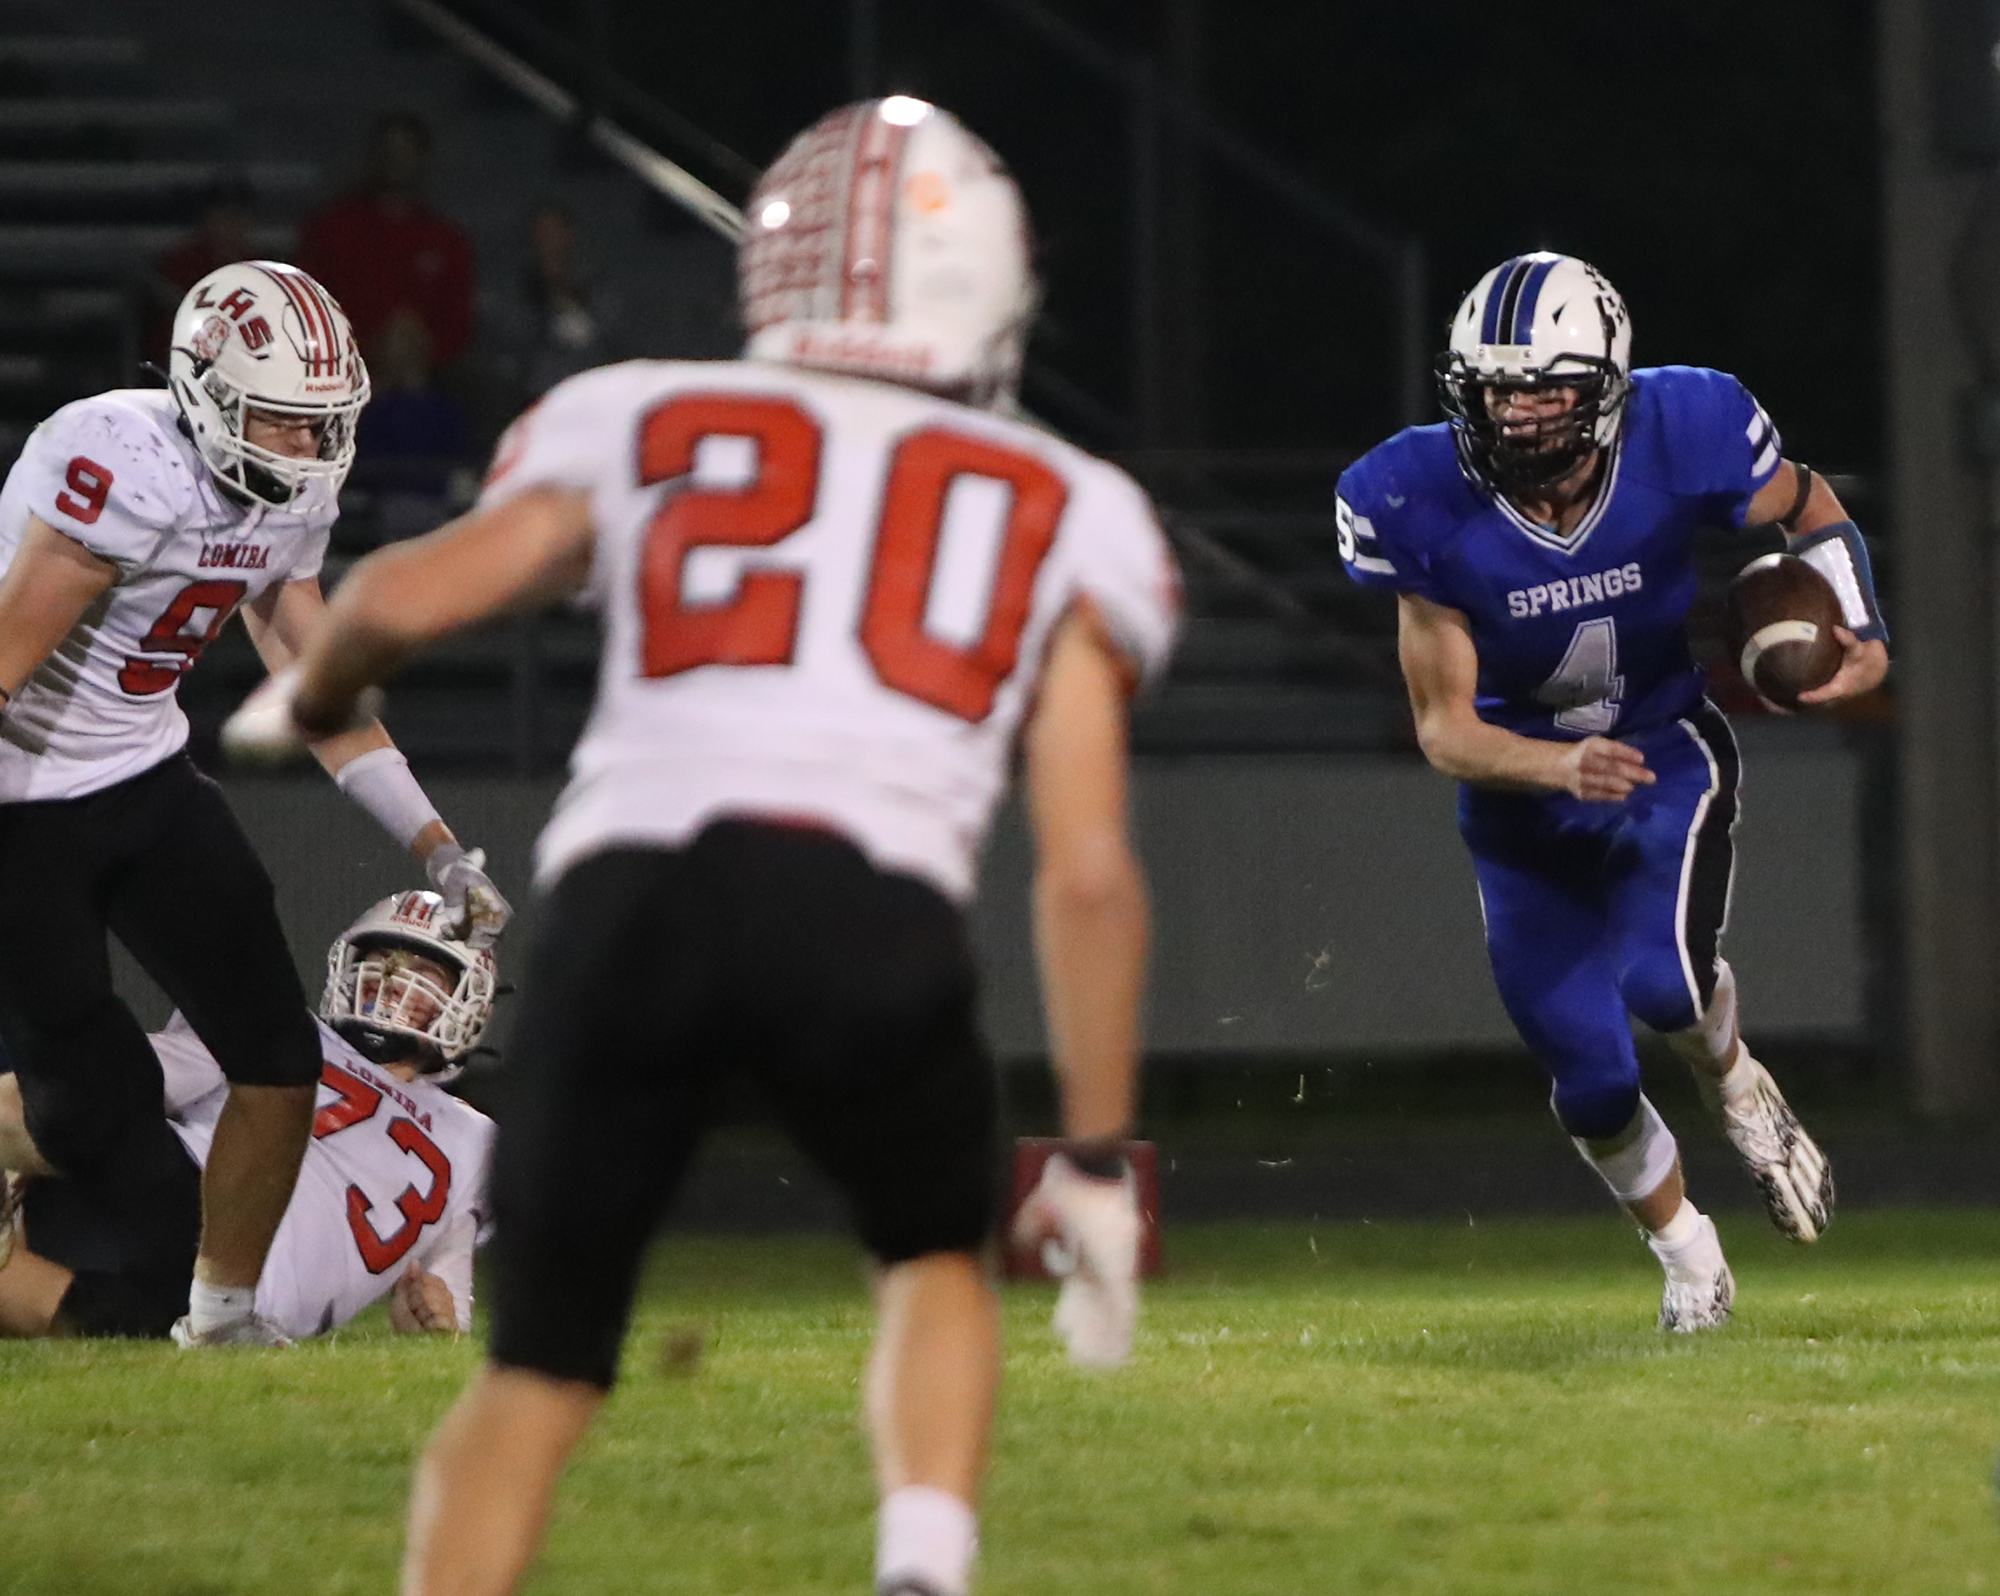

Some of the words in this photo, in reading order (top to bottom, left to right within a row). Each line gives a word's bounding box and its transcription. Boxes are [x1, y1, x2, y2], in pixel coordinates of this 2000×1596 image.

[194, 283, 274, 351] LHS
[55, 455, 114, 525] 9
[198, 543, 270, 569] LOMIRA
[636, 389, 1069, 725] 20
[1507, 562, 1643, 618] SPRINGS
[118, 578, 248, 694] 9
[1532, 615, 1625, 733] 4
[344, 1057, 433, 1133] LOMIRA
